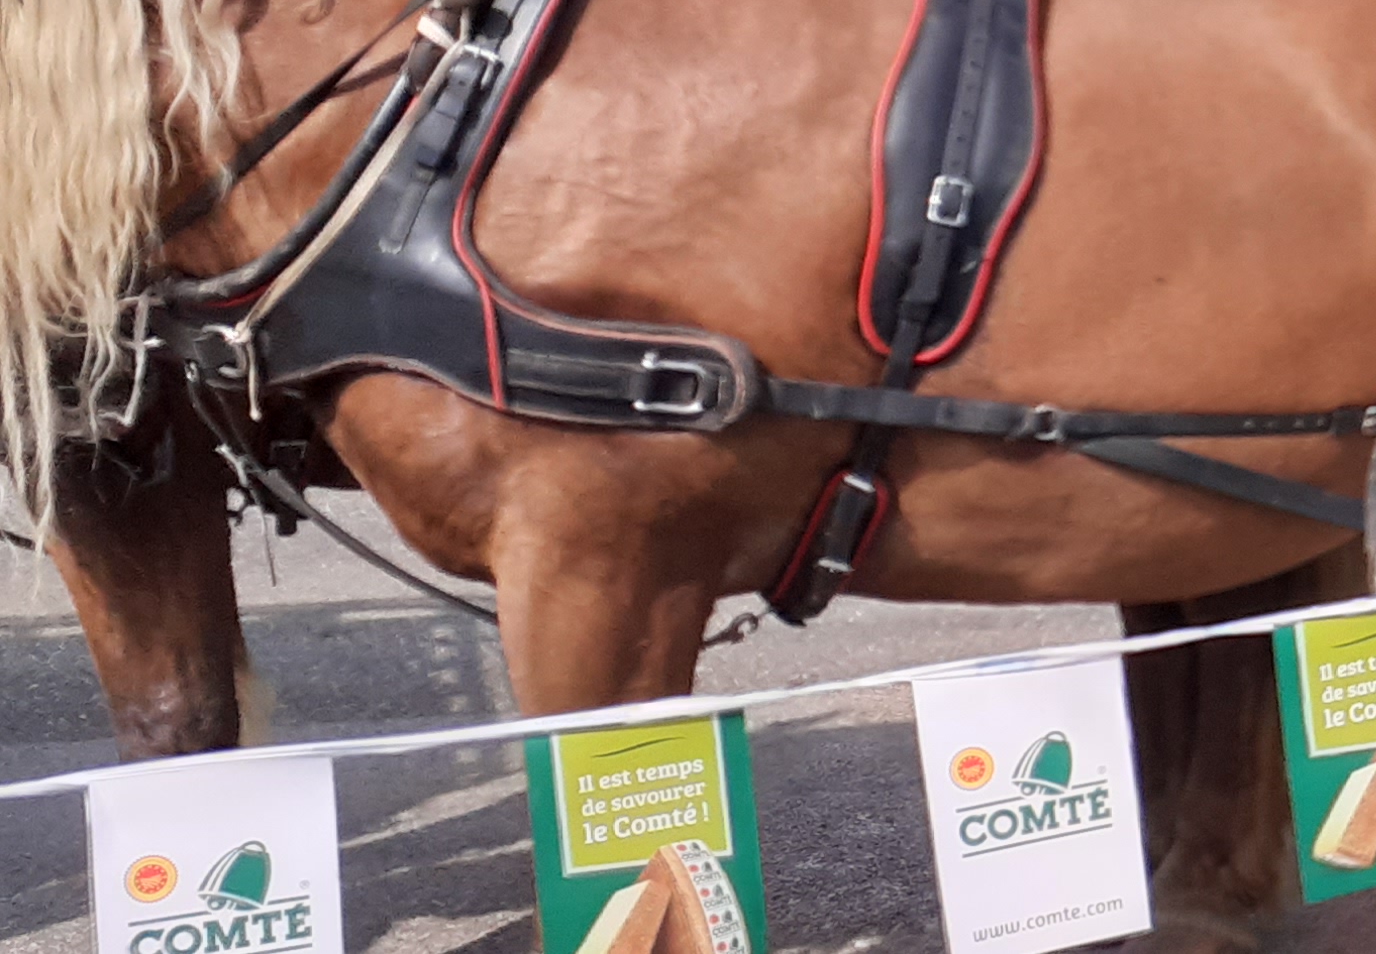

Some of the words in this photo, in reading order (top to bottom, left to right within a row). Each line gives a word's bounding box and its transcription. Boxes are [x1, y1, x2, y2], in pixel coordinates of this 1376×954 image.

[1319, 663, 1333, 682] Il
[1337, 658, 1365, 678] est
[1322, 685, 1344, 704] de
[1324, 708, 1346, 730] le
[578, 774, 595, 794] Il
[599, 771, 632, 789] est
[636, 758, 704, 783] temps
[581, 798, 607, 817] de
[611, 781, 707, 812] savourer
[959, 787, 1112, 847] COMTÉ
[582, 823, 608, 844] le
[613, 802, 697, 838] Comté
[129, 903, 312, 954] COMTÉ
[973, 897, 1124, 942] www.comte.com
